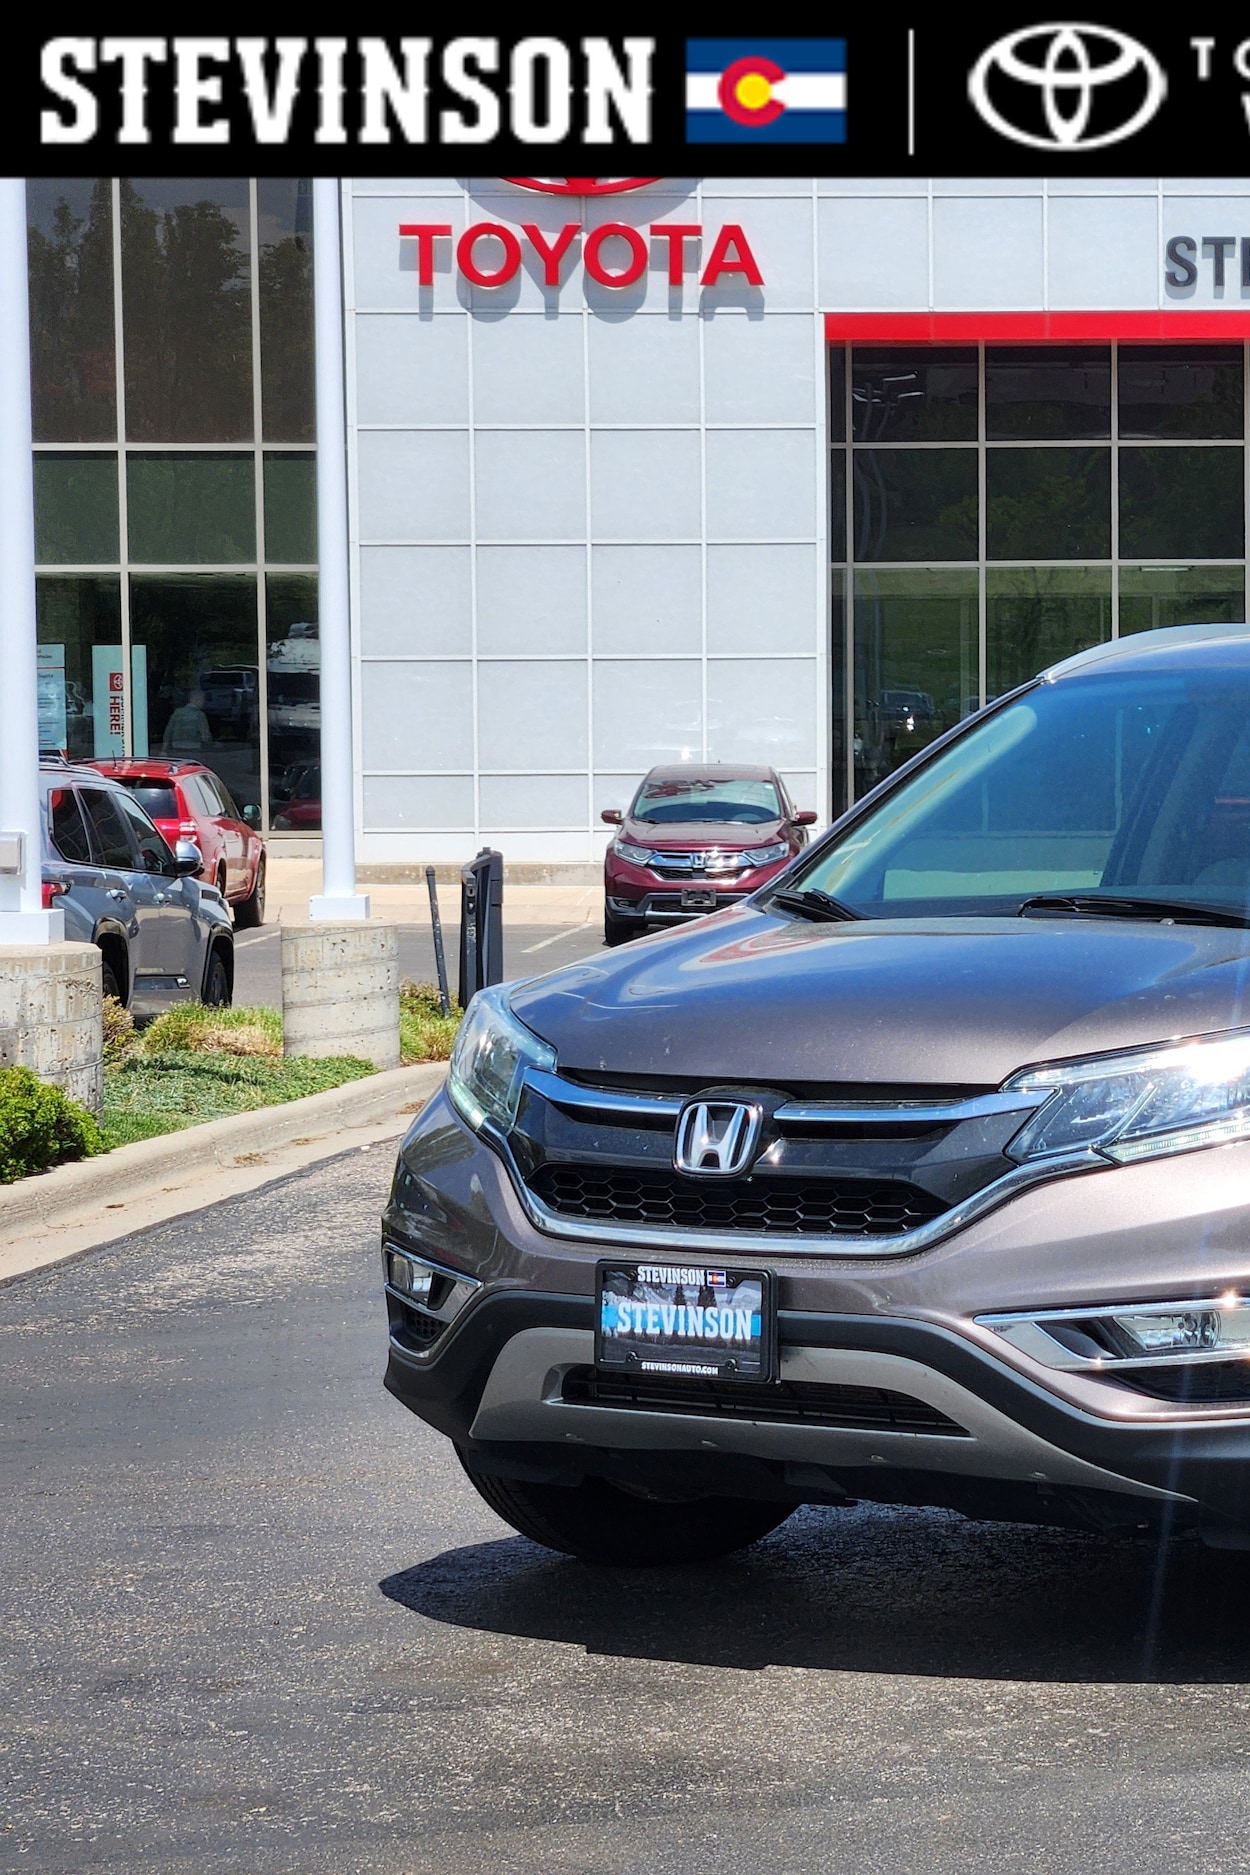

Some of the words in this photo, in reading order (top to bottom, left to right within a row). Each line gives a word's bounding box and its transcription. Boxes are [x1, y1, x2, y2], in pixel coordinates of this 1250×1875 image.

[399, 222, 764, 288] TOYOTA
[110, 696, 121, 734] HERE!
[637, 1266, 705, 1286] STEVINSON
[617, 1302, 752, 1340] STEVINSON
[641, 1361, 718, 1375] STEVINSONAUTO.COM
